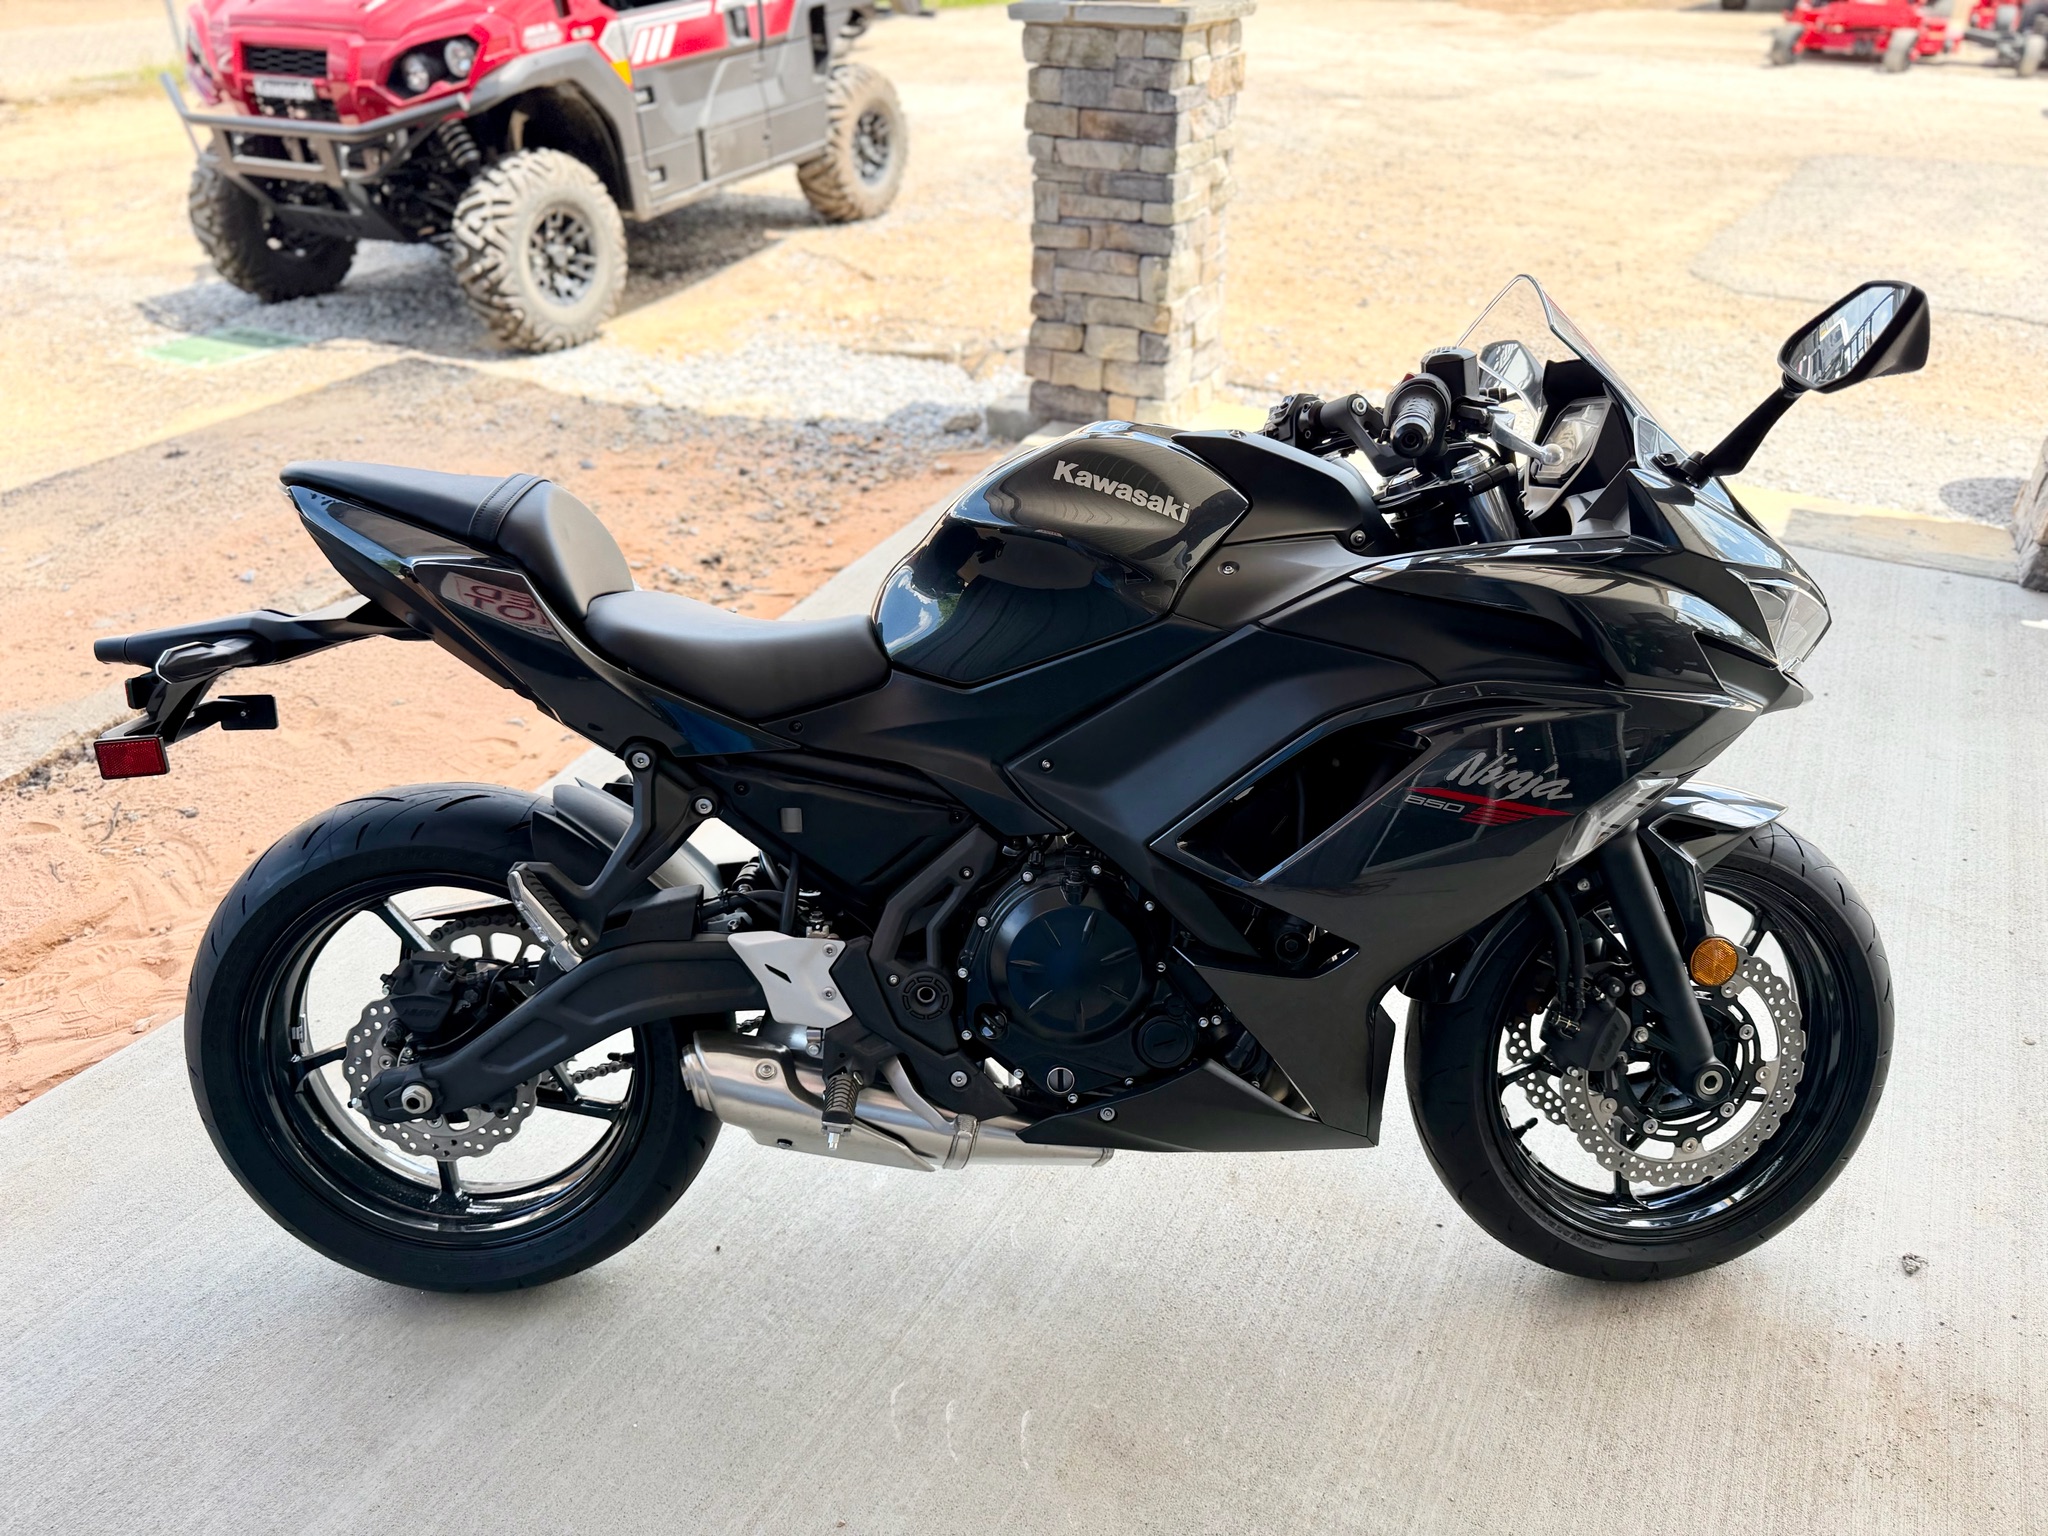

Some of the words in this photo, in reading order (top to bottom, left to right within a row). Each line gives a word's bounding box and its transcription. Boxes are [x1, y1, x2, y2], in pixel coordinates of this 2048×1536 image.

[1053, 460, 1190, 523] Kawasaki
[1446, 752, 1573, 802] Ninja
[1404, 795, 1465, 813] 650
